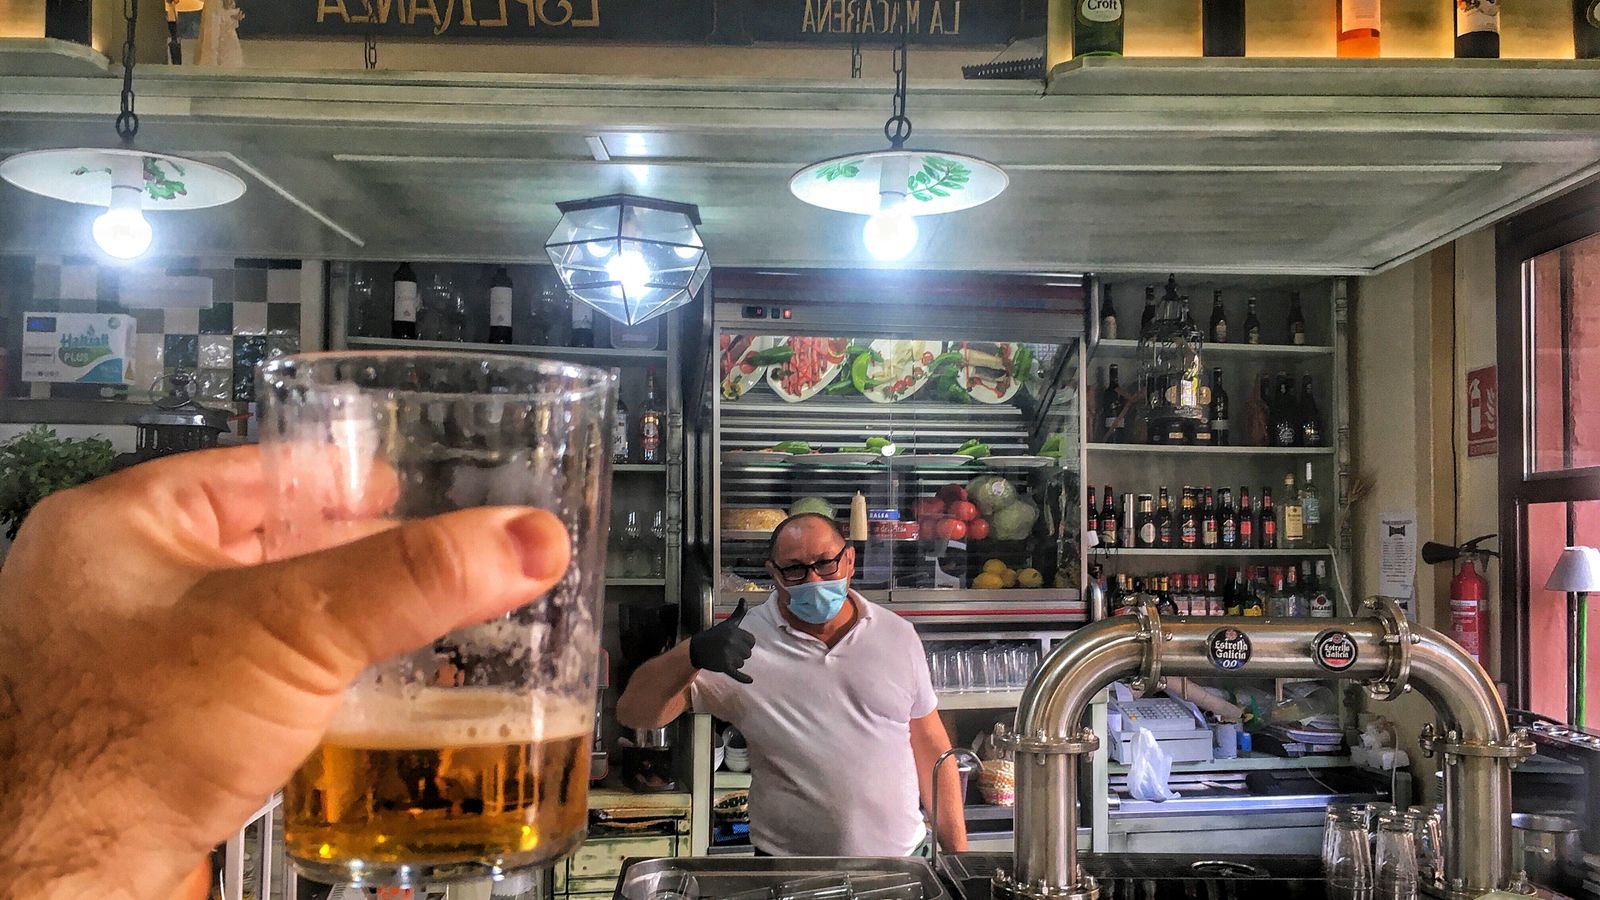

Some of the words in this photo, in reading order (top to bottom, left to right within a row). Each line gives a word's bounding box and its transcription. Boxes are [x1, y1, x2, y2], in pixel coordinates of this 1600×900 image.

[1214, 640, 1248, 651] Estrella
[1324, 644, 1350, 652] Estrella
[1215, 650, 1246, 660] Galicia
[1325, 650, 1349, 658] Galicia
